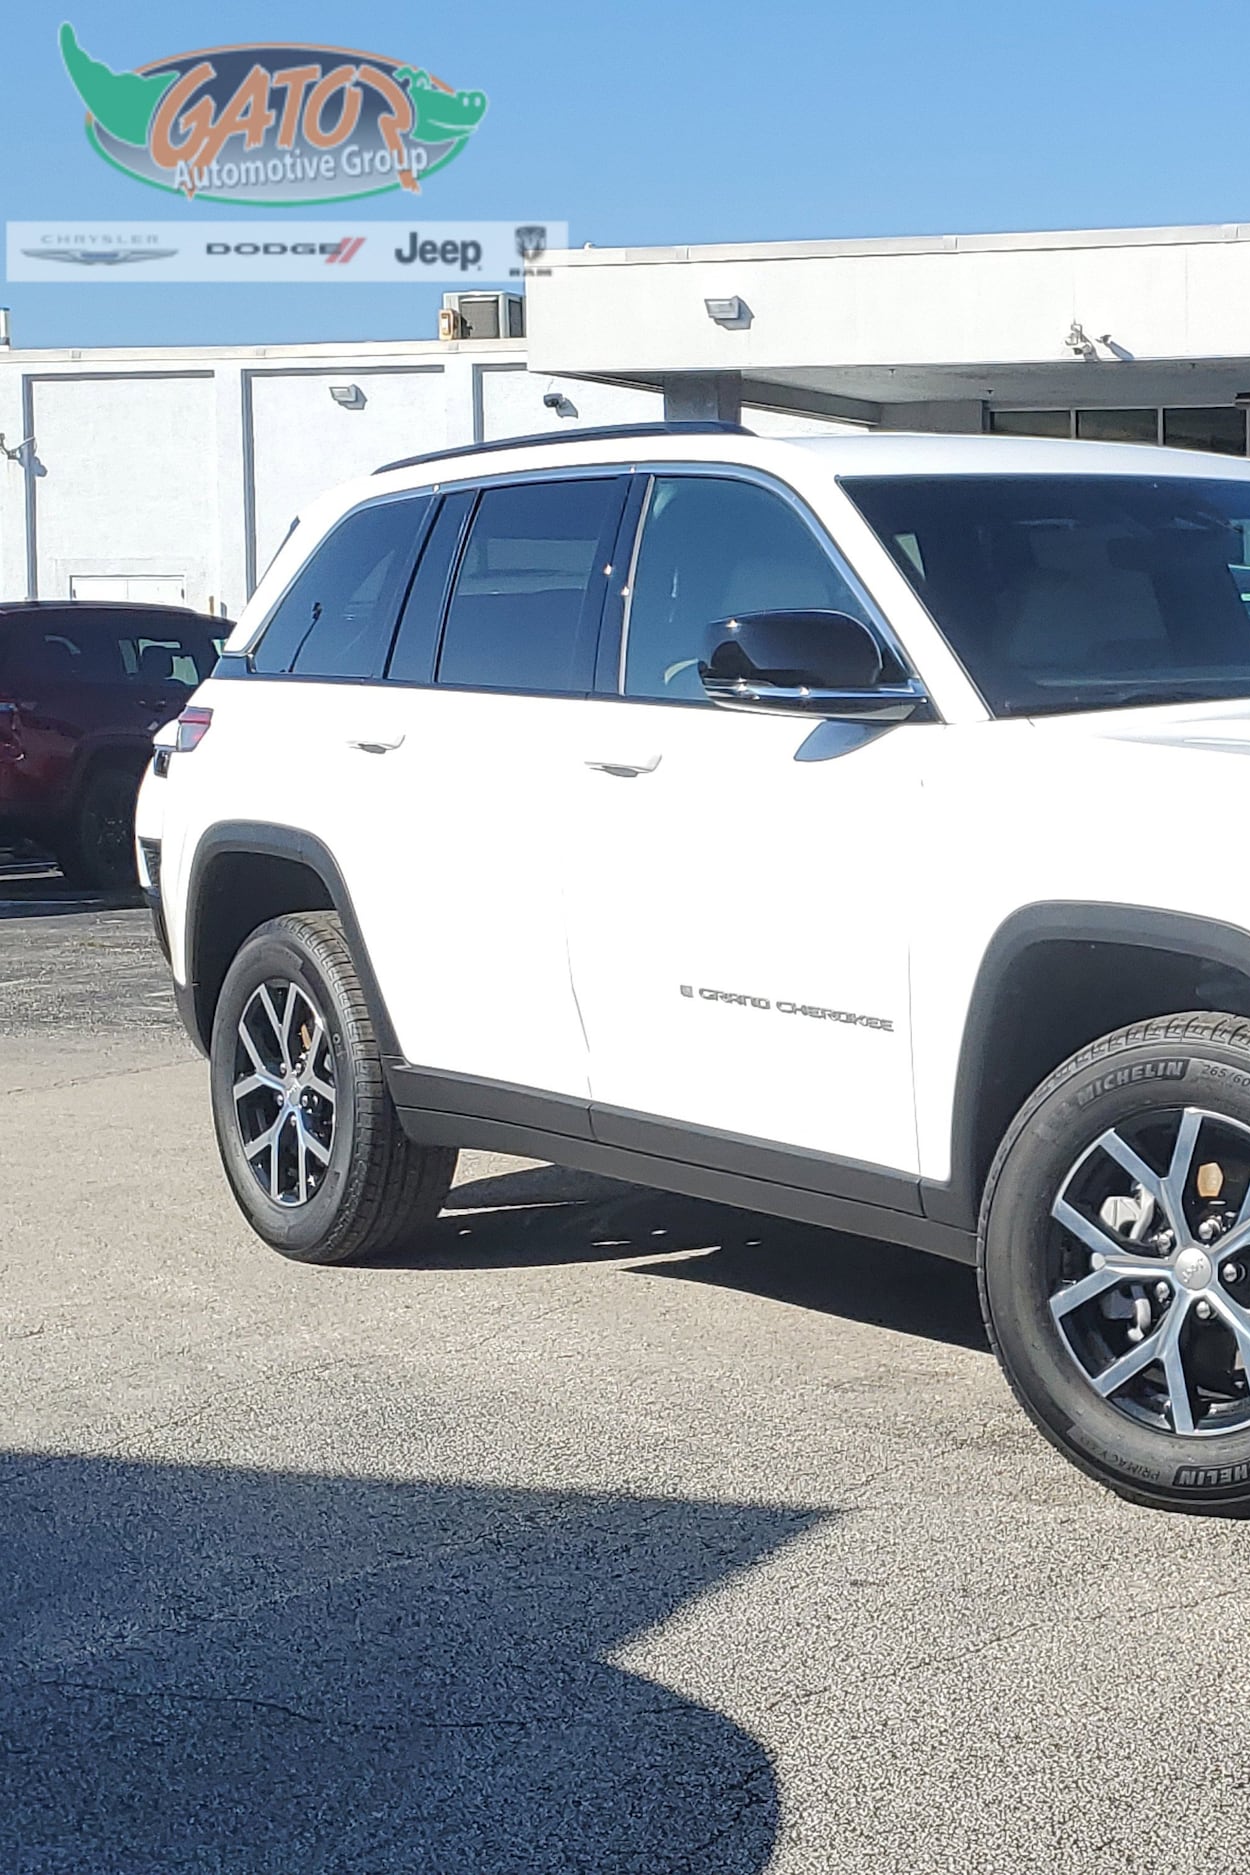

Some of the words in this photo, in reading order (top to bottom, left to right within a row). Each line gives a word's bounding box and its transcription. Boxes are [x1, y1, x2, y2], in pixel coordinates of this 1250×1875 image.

[699, 988, 770, 1009] GRAND
[776, 1001, 894, 1032] CHEROKEE
[1077, 1060, 1184, 1105] MICHELIN
